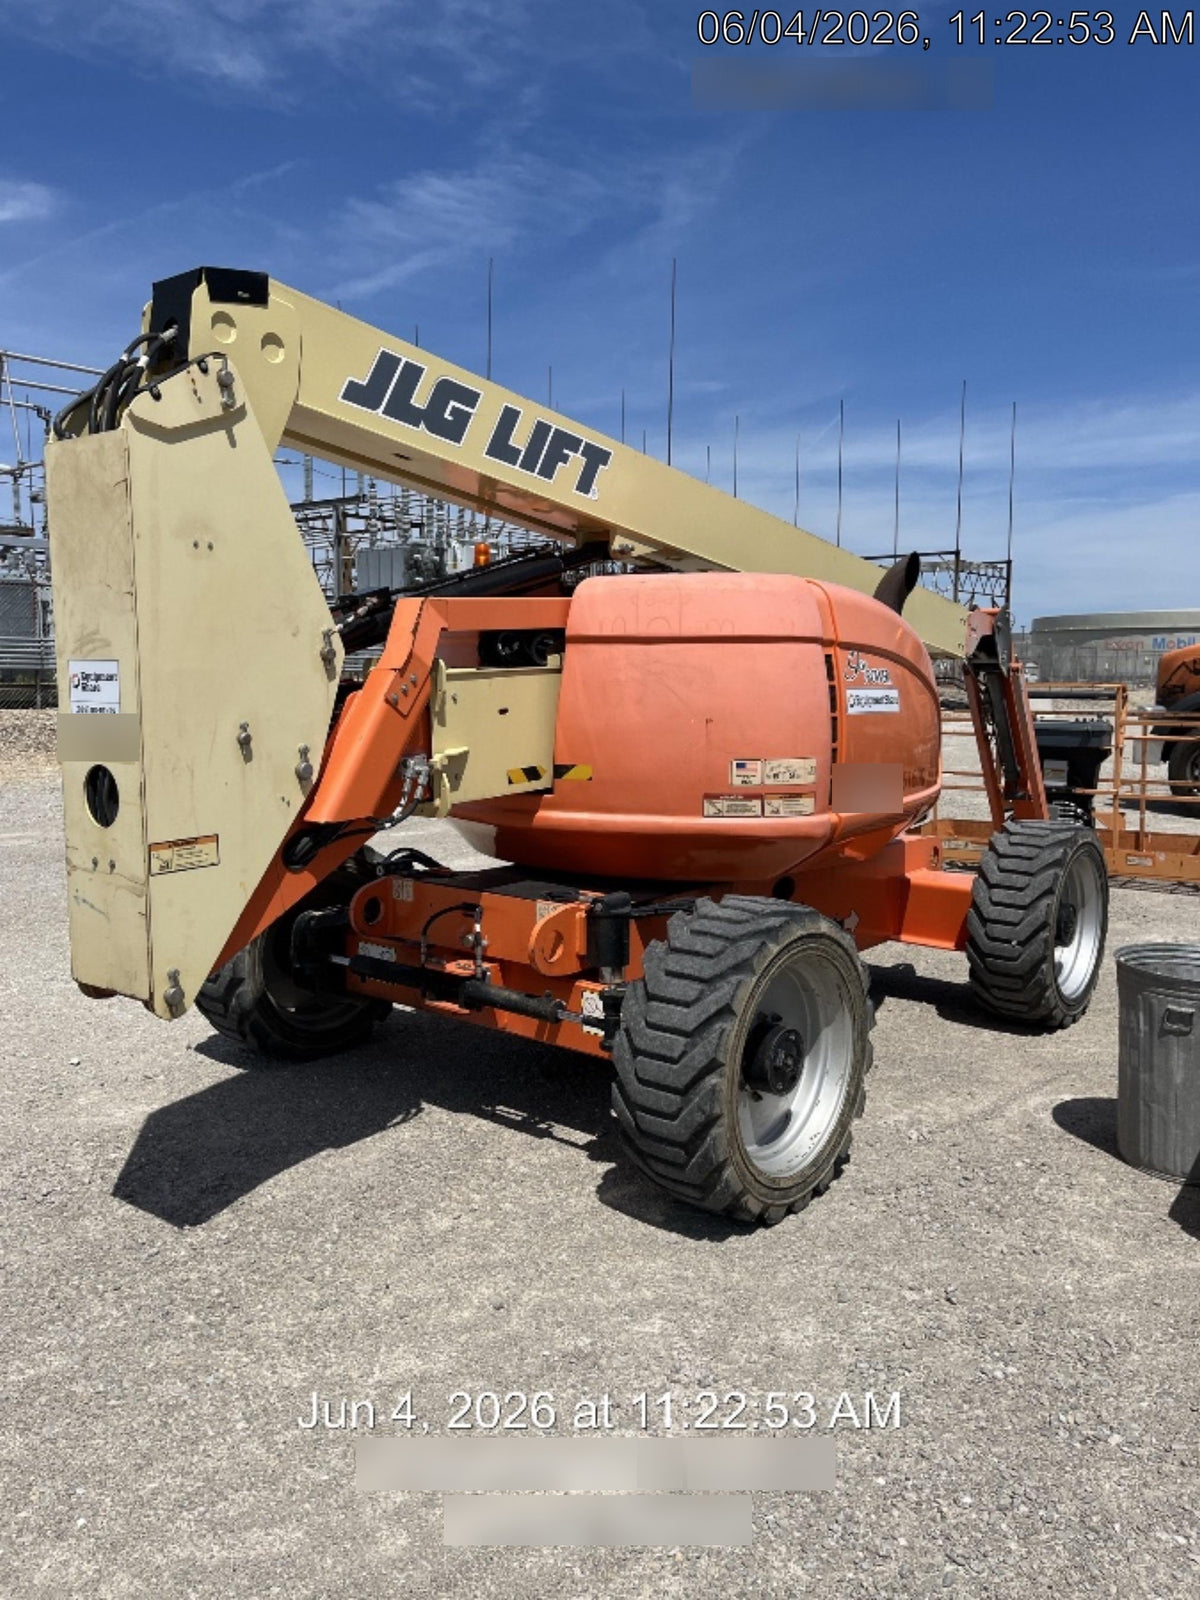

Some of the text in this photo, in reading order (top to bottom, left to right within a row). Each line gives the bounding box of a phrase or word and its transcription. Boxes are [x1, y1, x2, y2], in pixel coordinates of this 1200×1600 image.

[338, 346, 613, 500] JLG LIFT
[1152, 636, 1196, 650] Mobil
